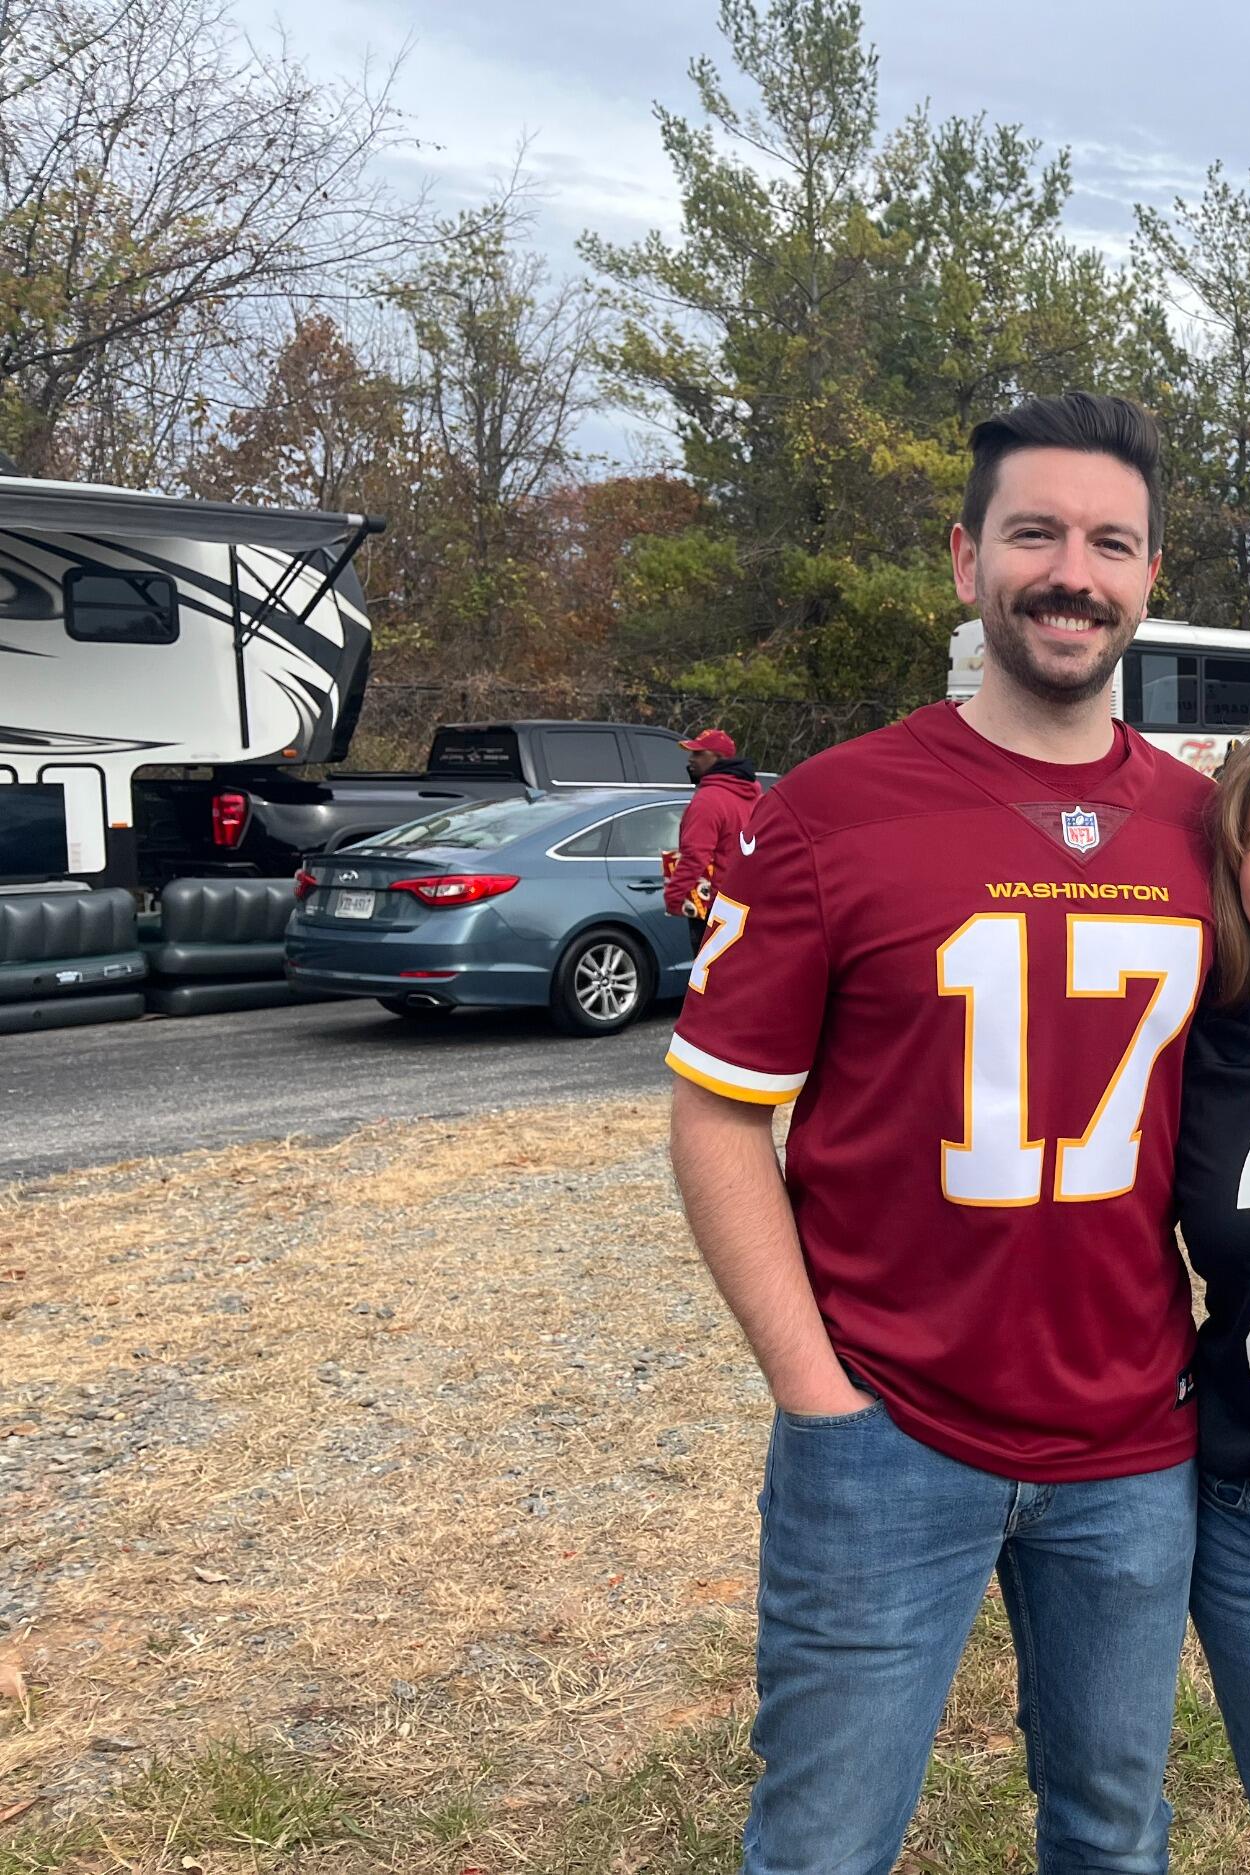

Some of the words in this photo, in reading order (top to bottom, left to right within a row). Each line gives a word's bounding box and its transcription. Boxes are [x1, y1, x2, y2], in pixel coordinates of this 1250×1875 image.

[1068, 826, 1094, 843] NFL
[985, 882, 1169, 901] WASHINGTON
[937, 912, 1203, 1207] 17
